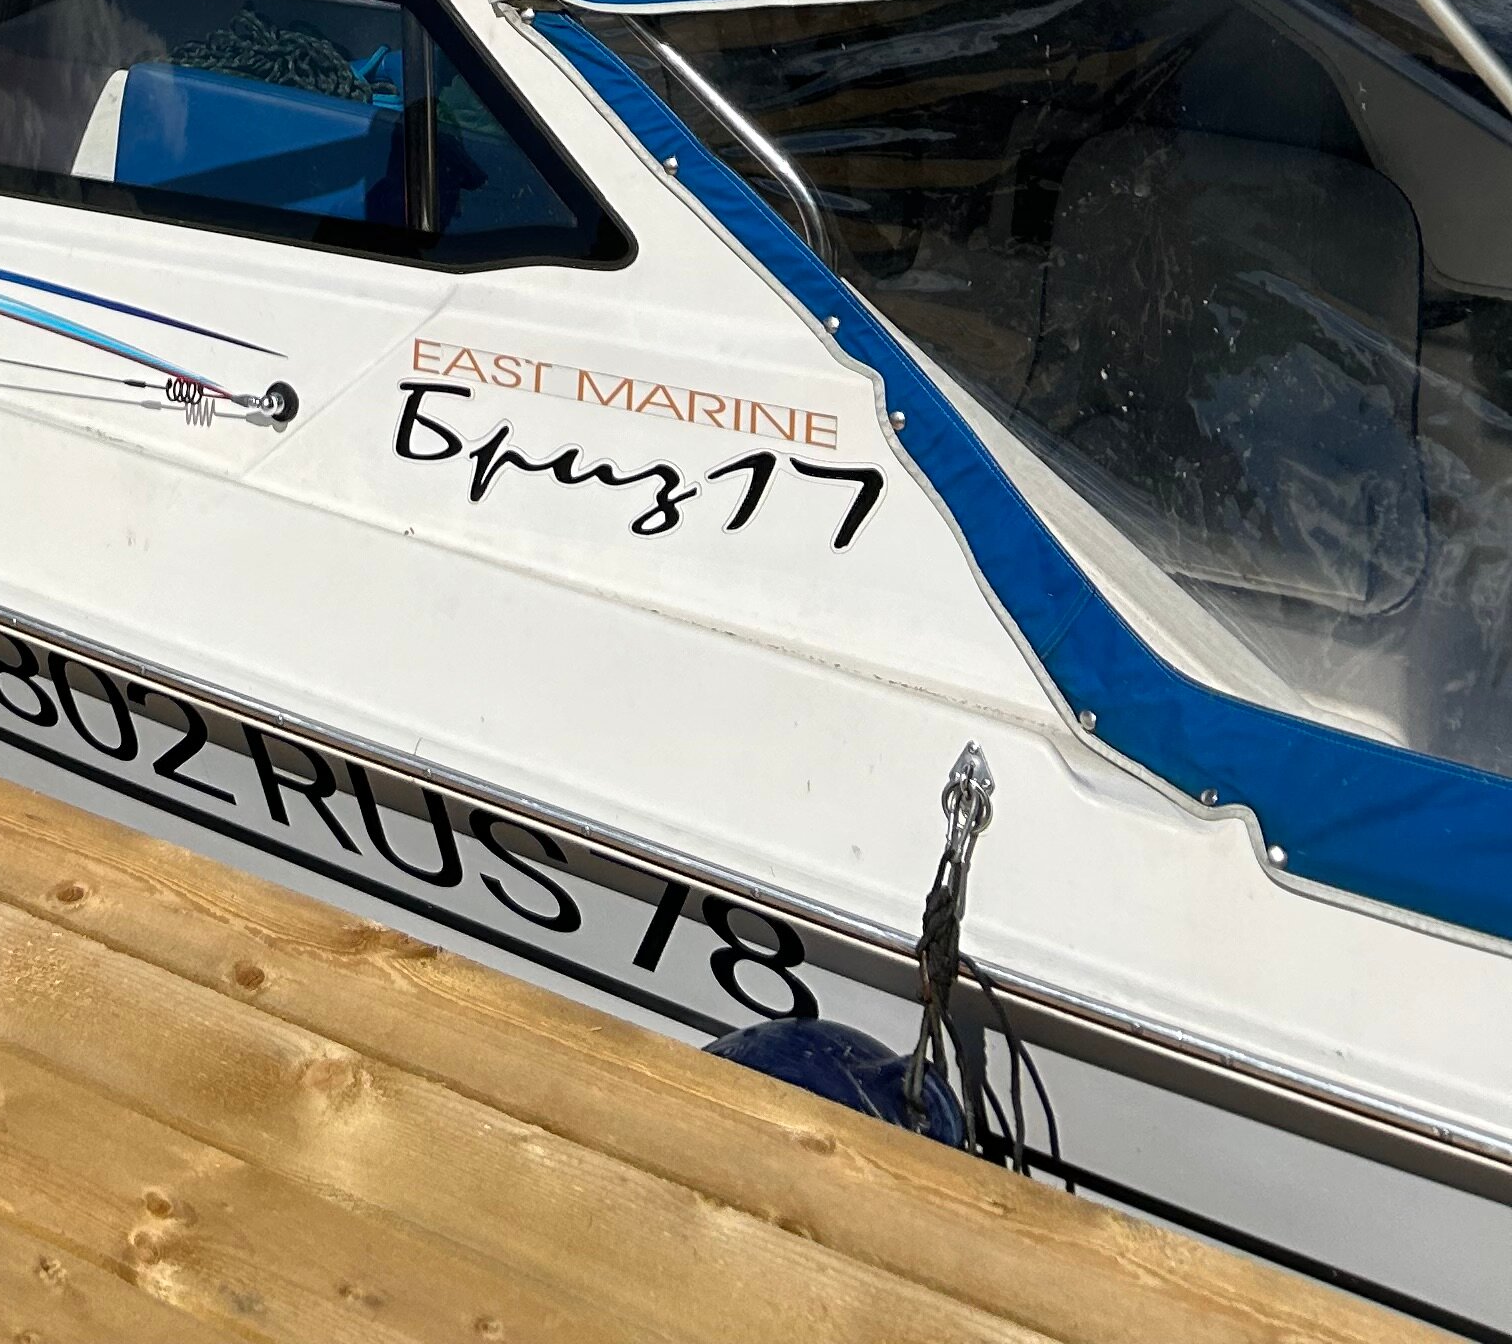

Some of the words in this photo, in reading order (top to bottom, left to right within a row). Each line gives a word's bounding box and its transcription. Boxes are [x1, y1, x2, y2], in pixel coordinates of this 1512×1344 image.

[395, 382, 697, 535] Бриз
[705, 449, 884, 548] 17
[413, 338, 553, 393] EAST
[577, 369, 837, 448] MARINE
[241, 712, 582, 933] RUS
